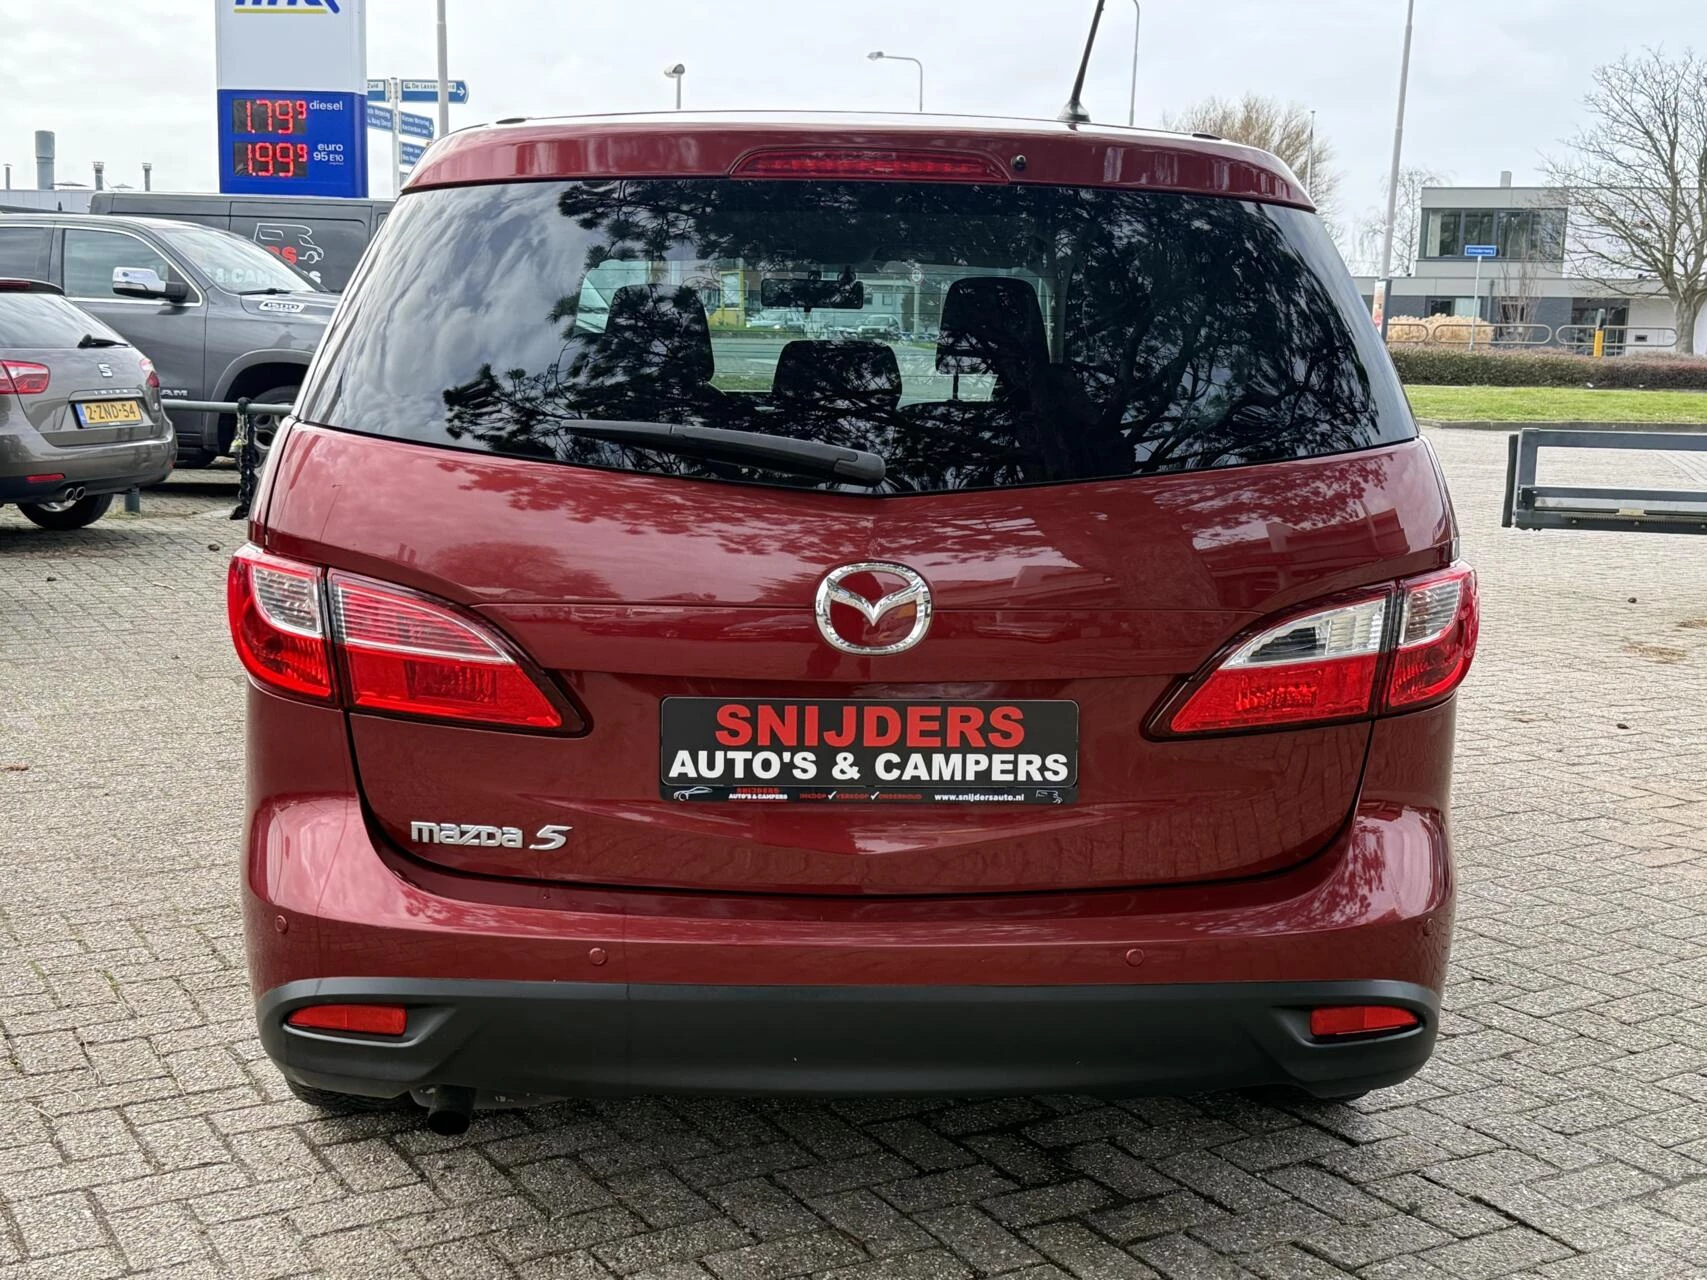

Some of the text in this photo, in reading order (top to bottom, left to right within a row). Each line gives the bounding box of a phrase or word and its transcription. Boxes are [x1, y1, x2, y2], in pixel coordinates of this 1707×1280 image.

[309, 100, 343, 111] diesel
[317, 143, 344, 152] euro
[313, 152, 344, 162] 95 E10
[85, 403, 137, 420] 2-ZND-54
[715, 704, 1026, 748] SNIJDERS
[668, 750, 1069, 782] AUTO'S & CAMPERS
[934, 793, 1025, 802] www.snijdersauto.nl
[528, 824, 573, 850] 5
